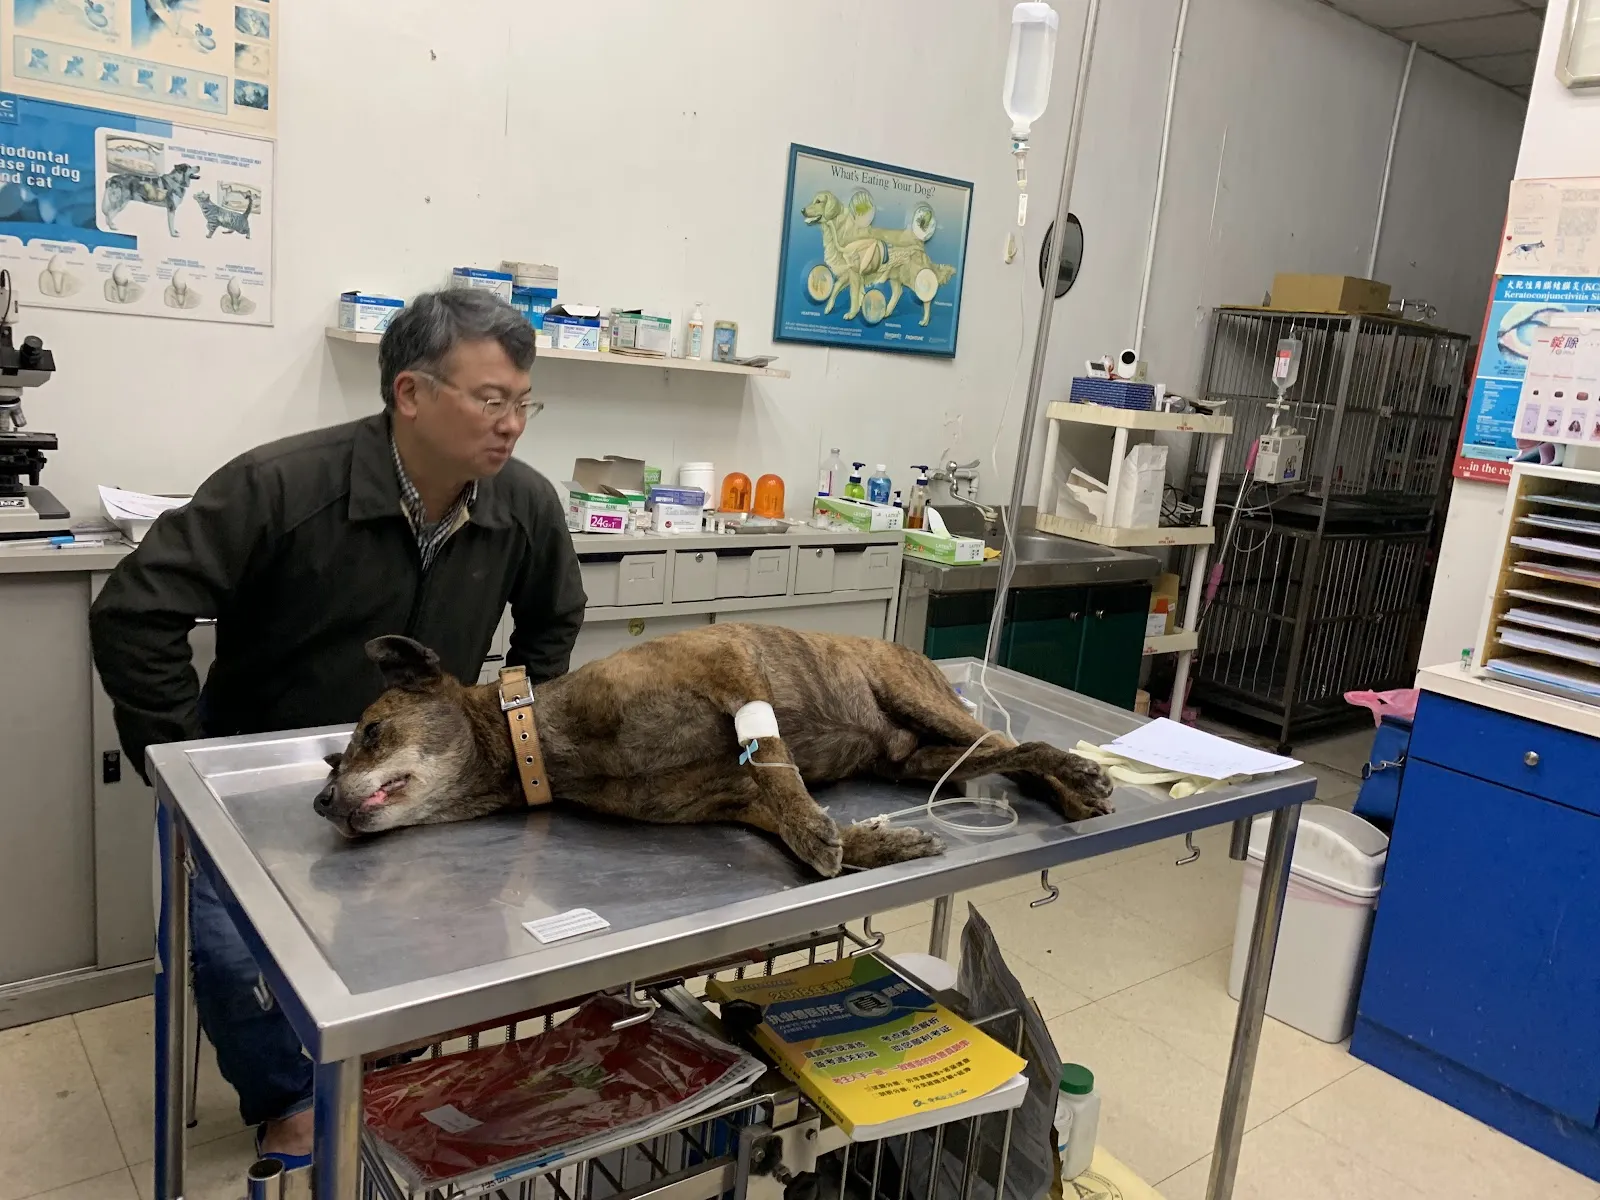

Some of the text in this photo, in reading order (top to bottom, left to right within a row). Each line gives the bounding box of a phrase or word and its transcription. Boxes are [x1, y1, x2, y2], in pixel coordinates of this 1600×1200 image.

[31, 161, 45, 175] in
[51, 164, 80, 183] dog
[26, 176, 53, 188] cat
[831, 165, 936, 199] What's Eating Your Dog?
[1504, 290, 1589, 301] Keratoconjunctivitis
[1481, 463, 1497, 473] the
